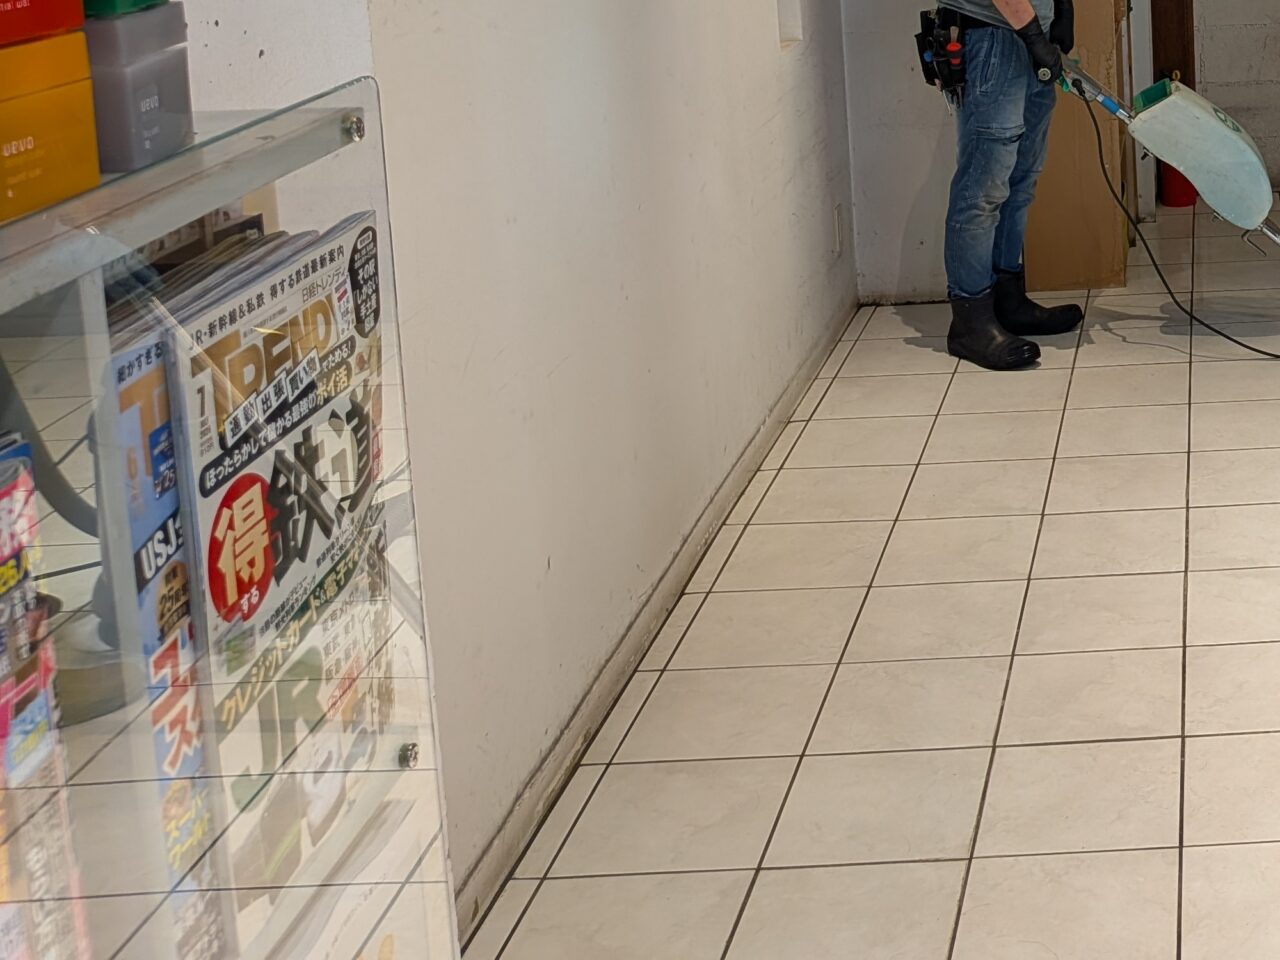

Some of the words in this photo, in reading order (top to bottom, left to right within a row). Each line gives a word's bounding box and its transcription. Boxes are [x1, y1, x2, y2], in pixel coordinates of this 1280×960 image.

[190, 293, 337, 435] TREND
[261, 376, 286, 415] 出張
[140, 517, 183, 580] USJ
[214, 481, 270, 607] 得
[239, 585, 260, 613] する
